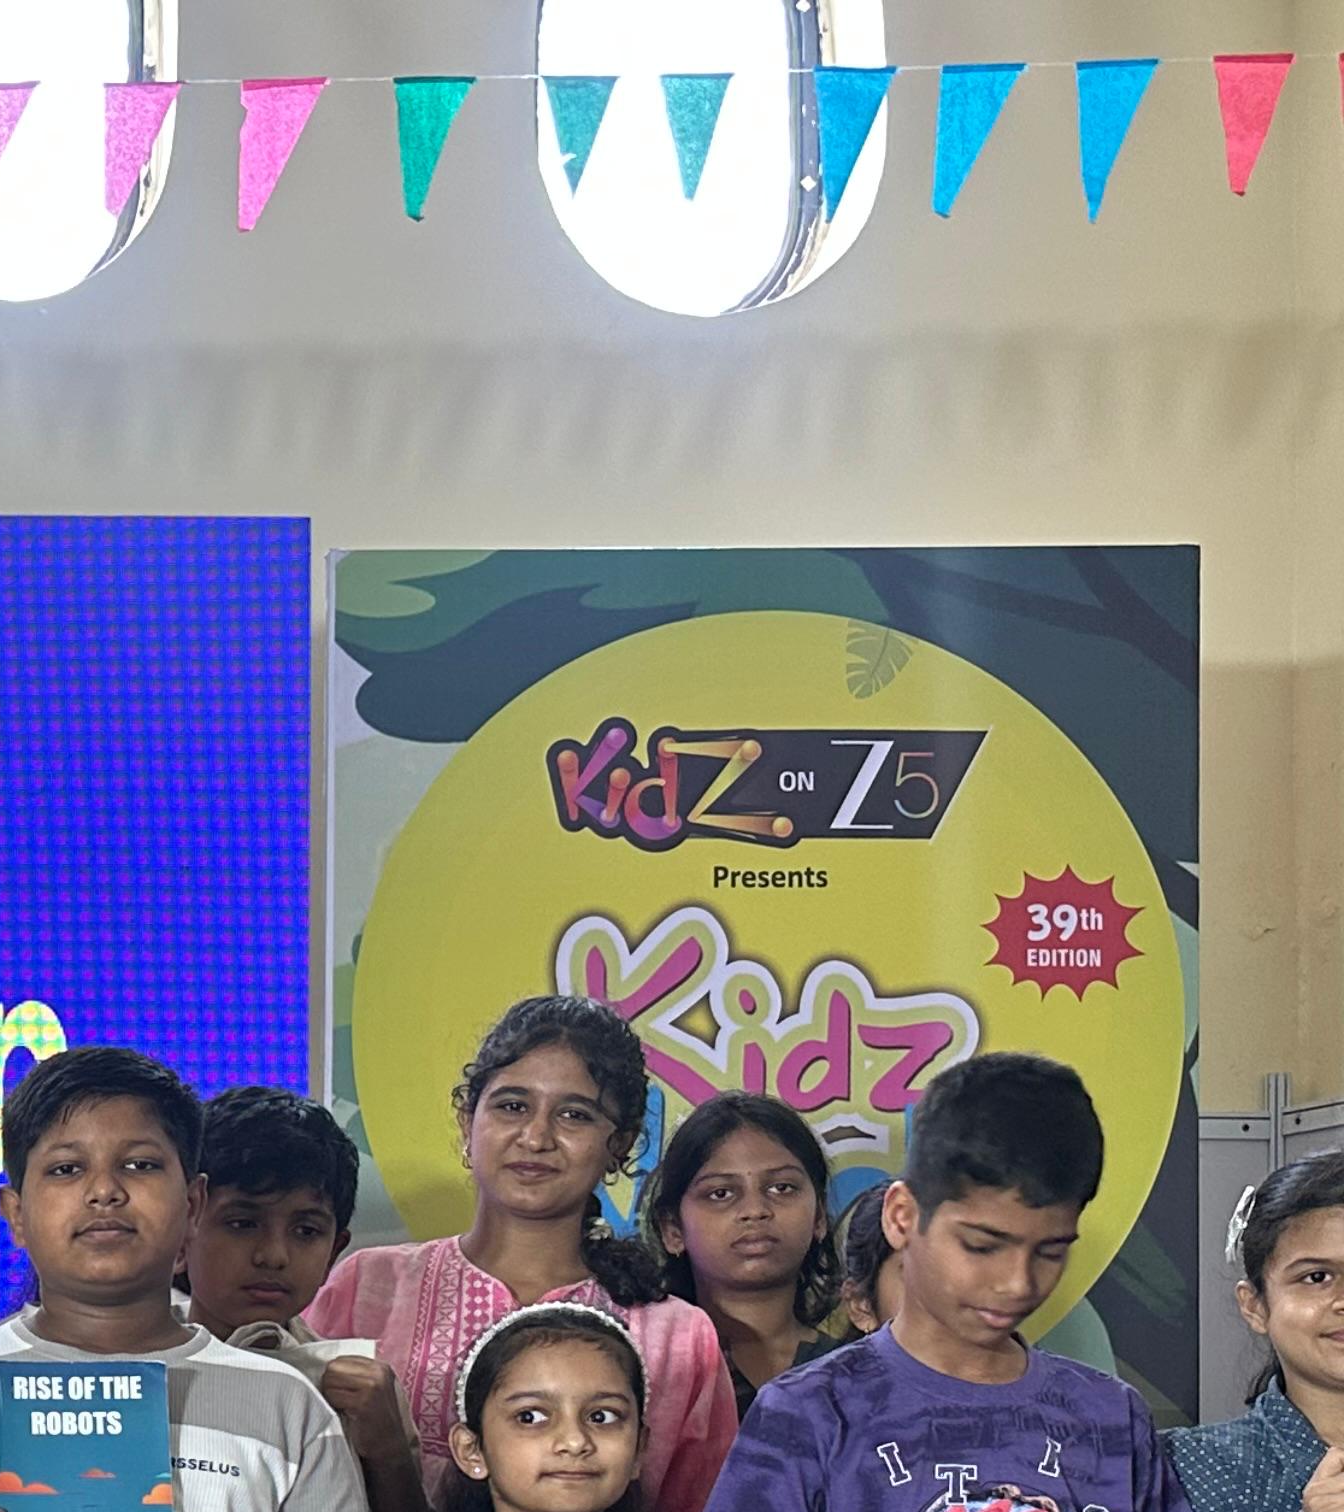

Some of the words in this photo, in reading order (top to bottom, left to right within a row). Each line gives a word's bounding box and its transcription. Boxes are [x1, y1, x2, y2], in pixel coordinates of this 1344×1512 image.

[778, 770, 814, 792] ON
[829, 739, 940, 829] Z5
[712, 865, 828, 889] Presents
[1026, 903, 1104, 942] 39th
[1026, 948, 1102, 968] EDITION
[13, 1376, 63, 1400] RISE
[68, 1376, 95, 1400] OF
[98, 1375, 143, 1400] THE
[31, 1411, 123, 1436] ROBOTS
